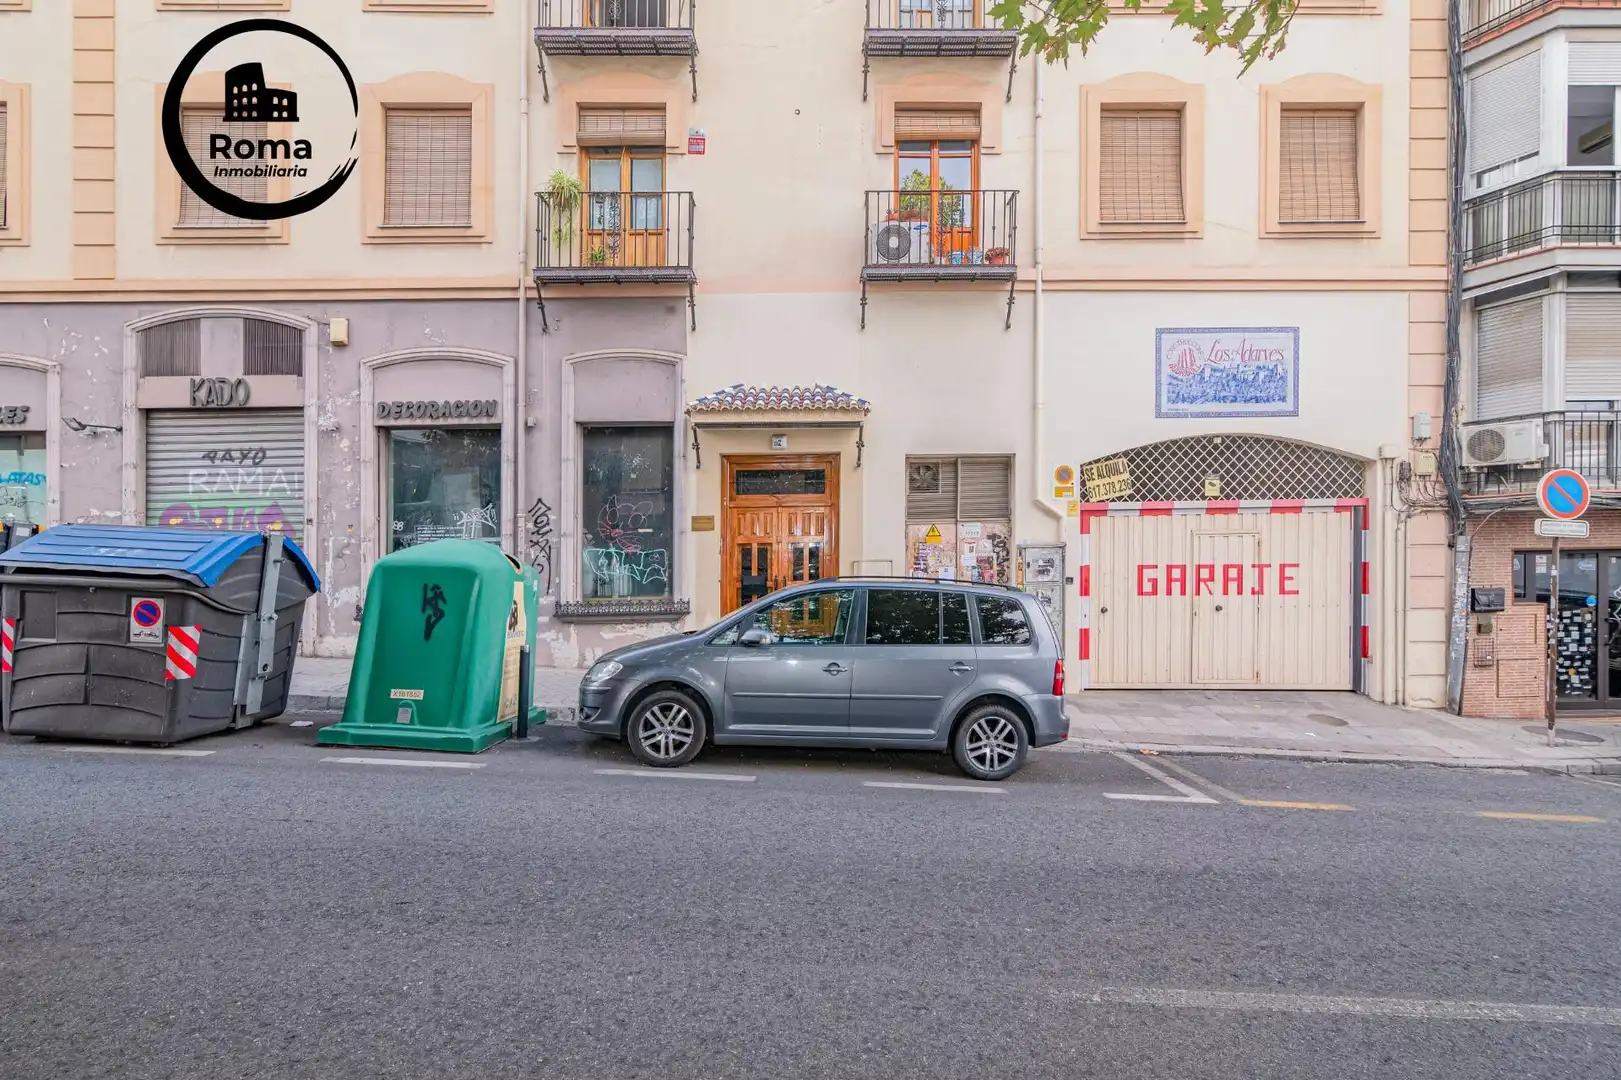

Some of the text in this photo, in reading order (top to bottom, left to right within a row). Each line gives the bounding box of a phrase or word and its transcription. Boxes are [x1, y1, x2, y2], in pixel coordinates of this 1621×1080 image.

[1206, 338, 1285, 364] Los Adarves
[189, 377, 250, 406] KADO
[377, 399, 498, 419] DECORACION
[1084, 461, 1128, 482] SE ALQUILA
[1087, 478, 1132, 499] 617.378.236
[1136, 563, 1300, 597] GARAJE
